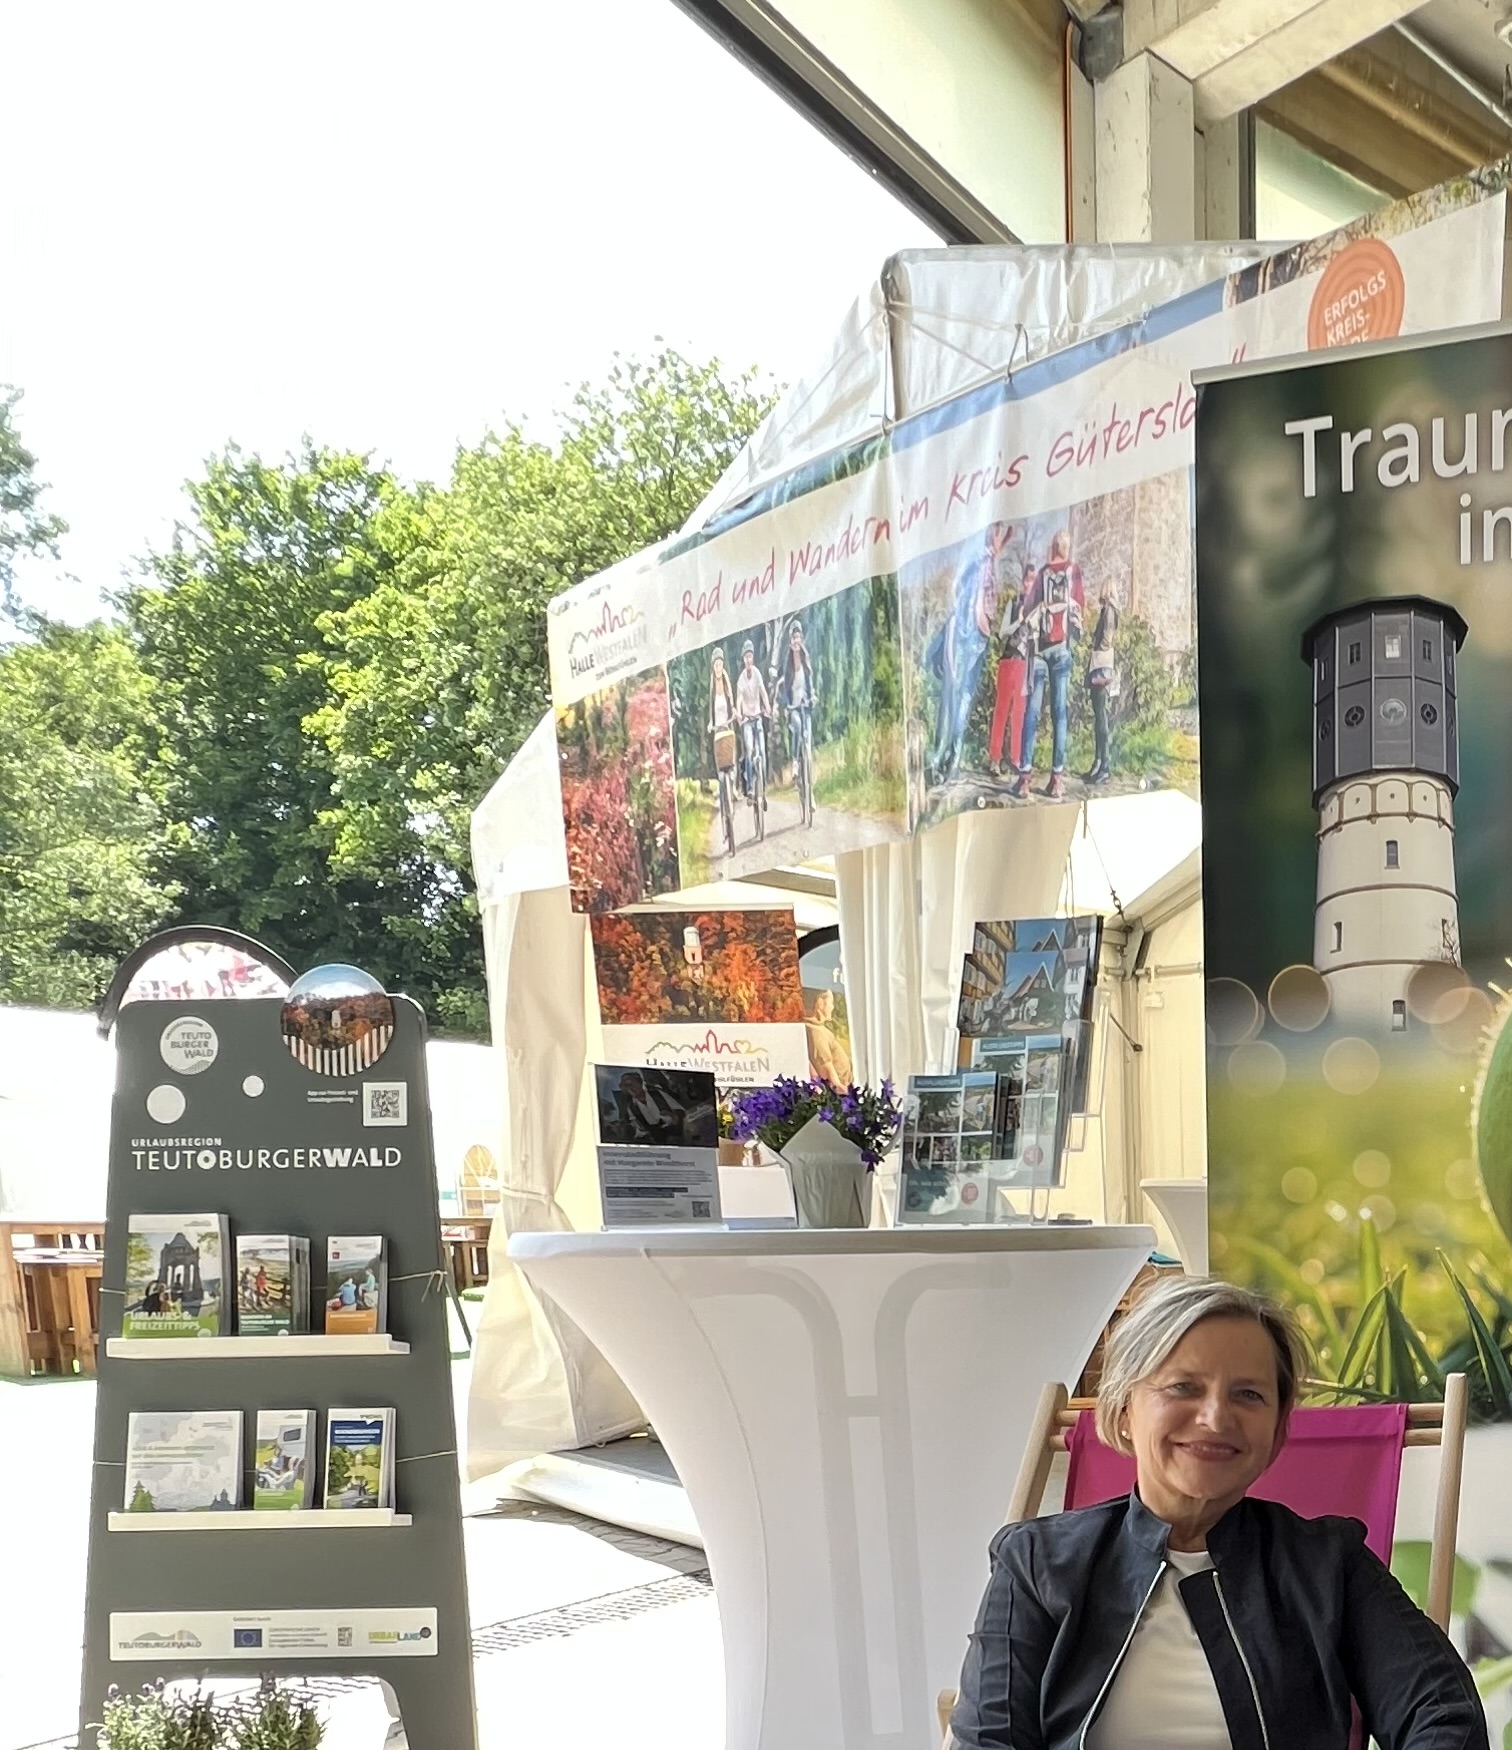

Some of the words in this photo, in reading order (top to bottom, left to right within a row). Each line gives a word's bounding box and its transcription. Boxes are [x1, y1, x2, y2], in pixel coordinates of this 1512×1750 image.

[1324, 270, 1386, 326] ERFOLGS
[1326, 309, 1370, 347] KREIS-
[732, 546, 775, 605] und
[788, 514, 890, 587] Wandern
[899, 496, 929, 535] im
[181, 1031, 212, 1040] TEUTO
[184, 1049, 214, 1059] WALD
[131, 1137, 222, 1147] URLAUBSREGION
[131, 1147, 401, 1170] TEUTOBURGERWALD
